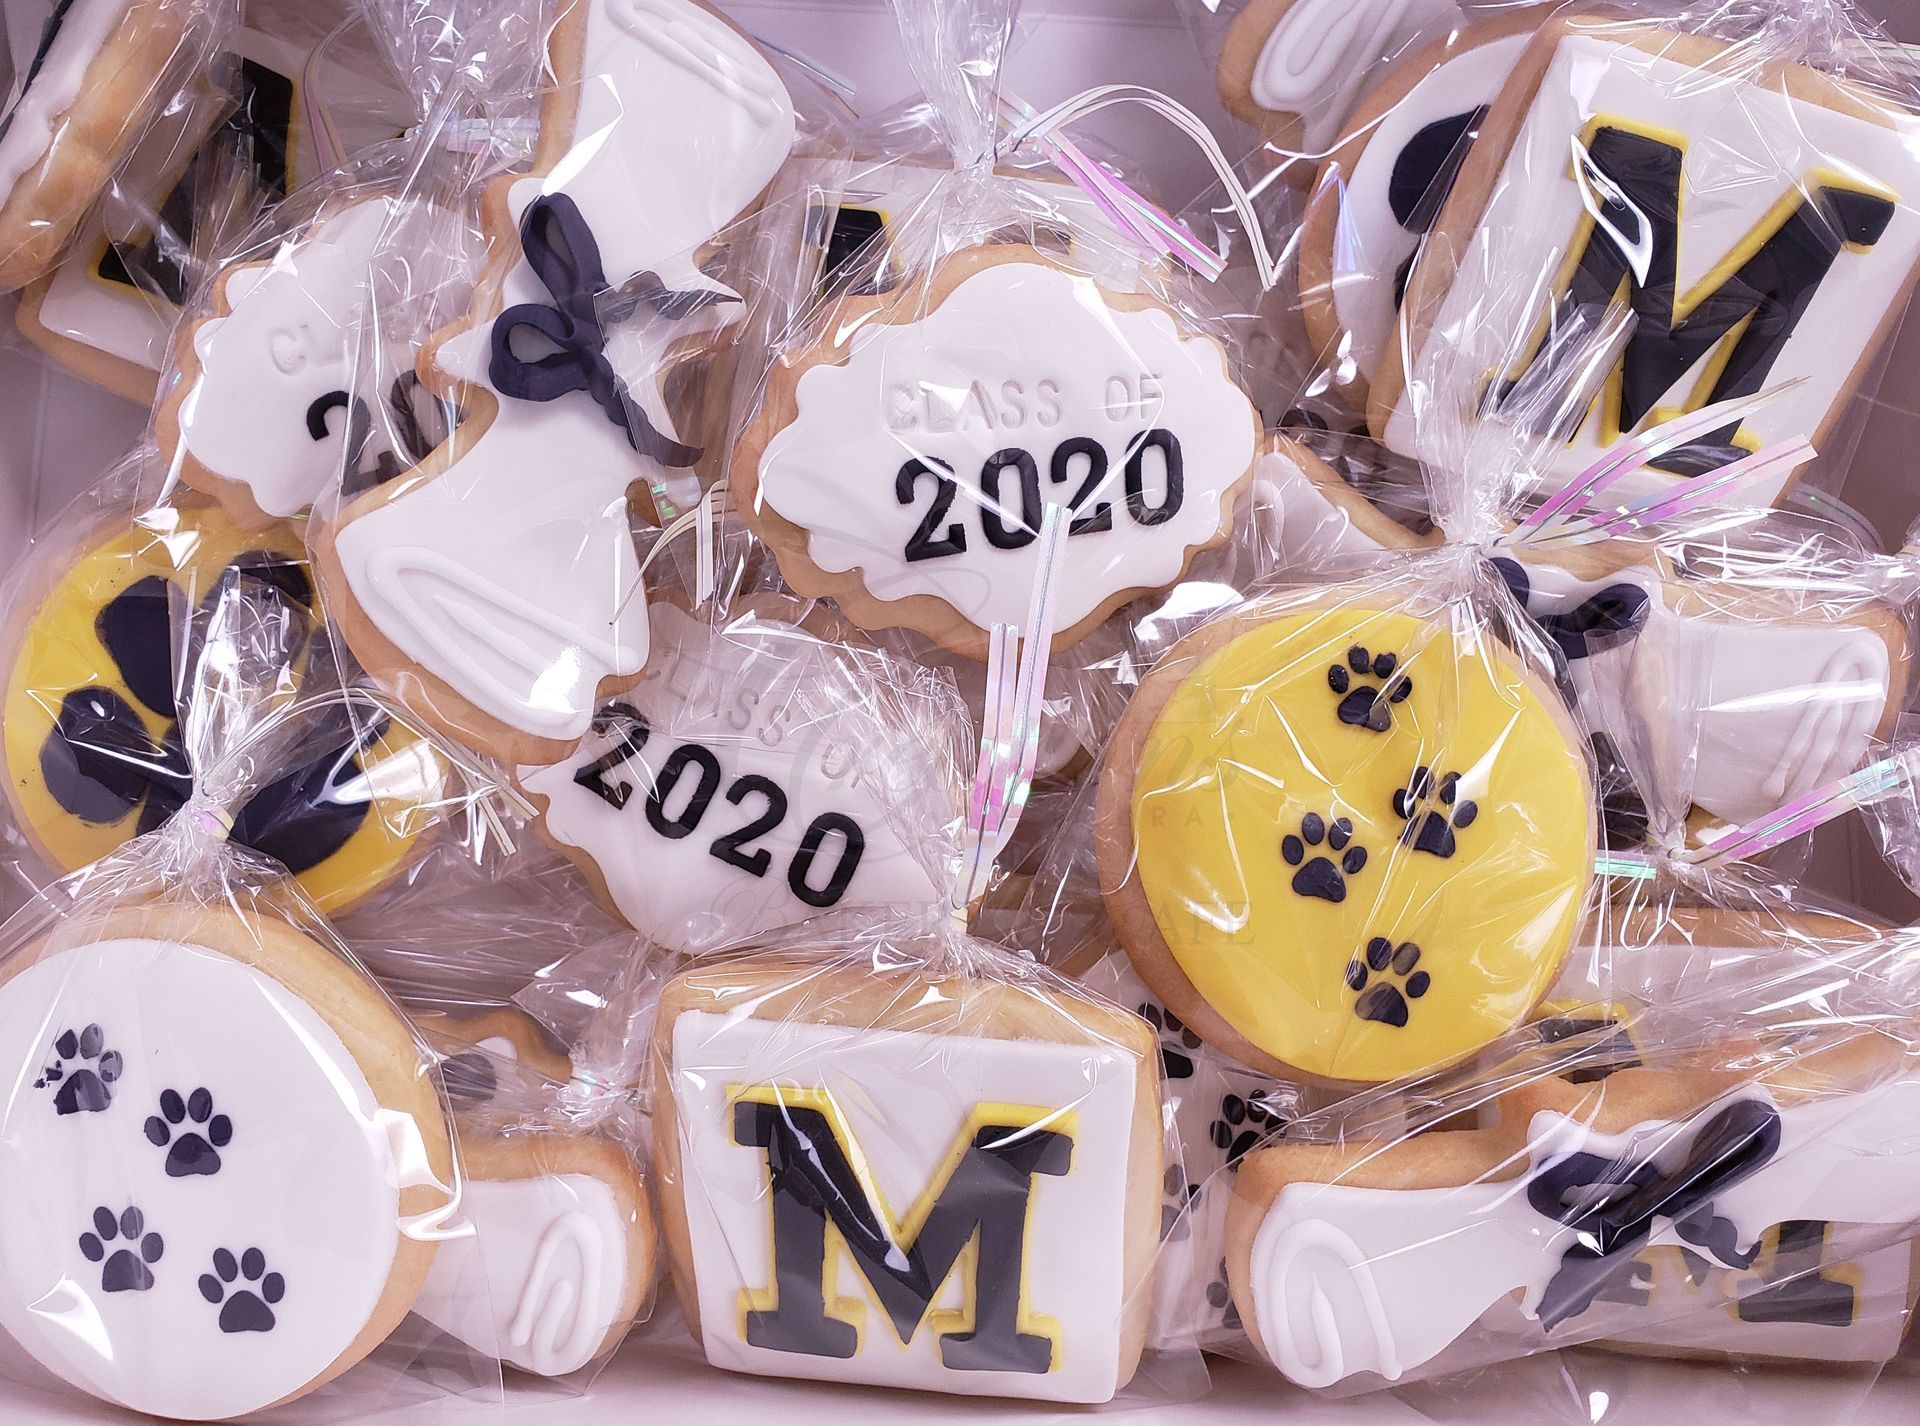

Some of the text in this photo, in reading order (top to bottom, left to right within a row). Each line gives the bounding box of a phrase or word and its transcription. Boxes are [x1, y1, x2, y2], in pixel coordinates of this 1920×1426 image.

[1475, 113, 1900, 478] M
[887, 374, 1164, 432] CLASS OF
[896, 428, 1184, 562] 2020
[573, 701, 865, 907] 2020
[726, 1084, 1080, 1374] M
